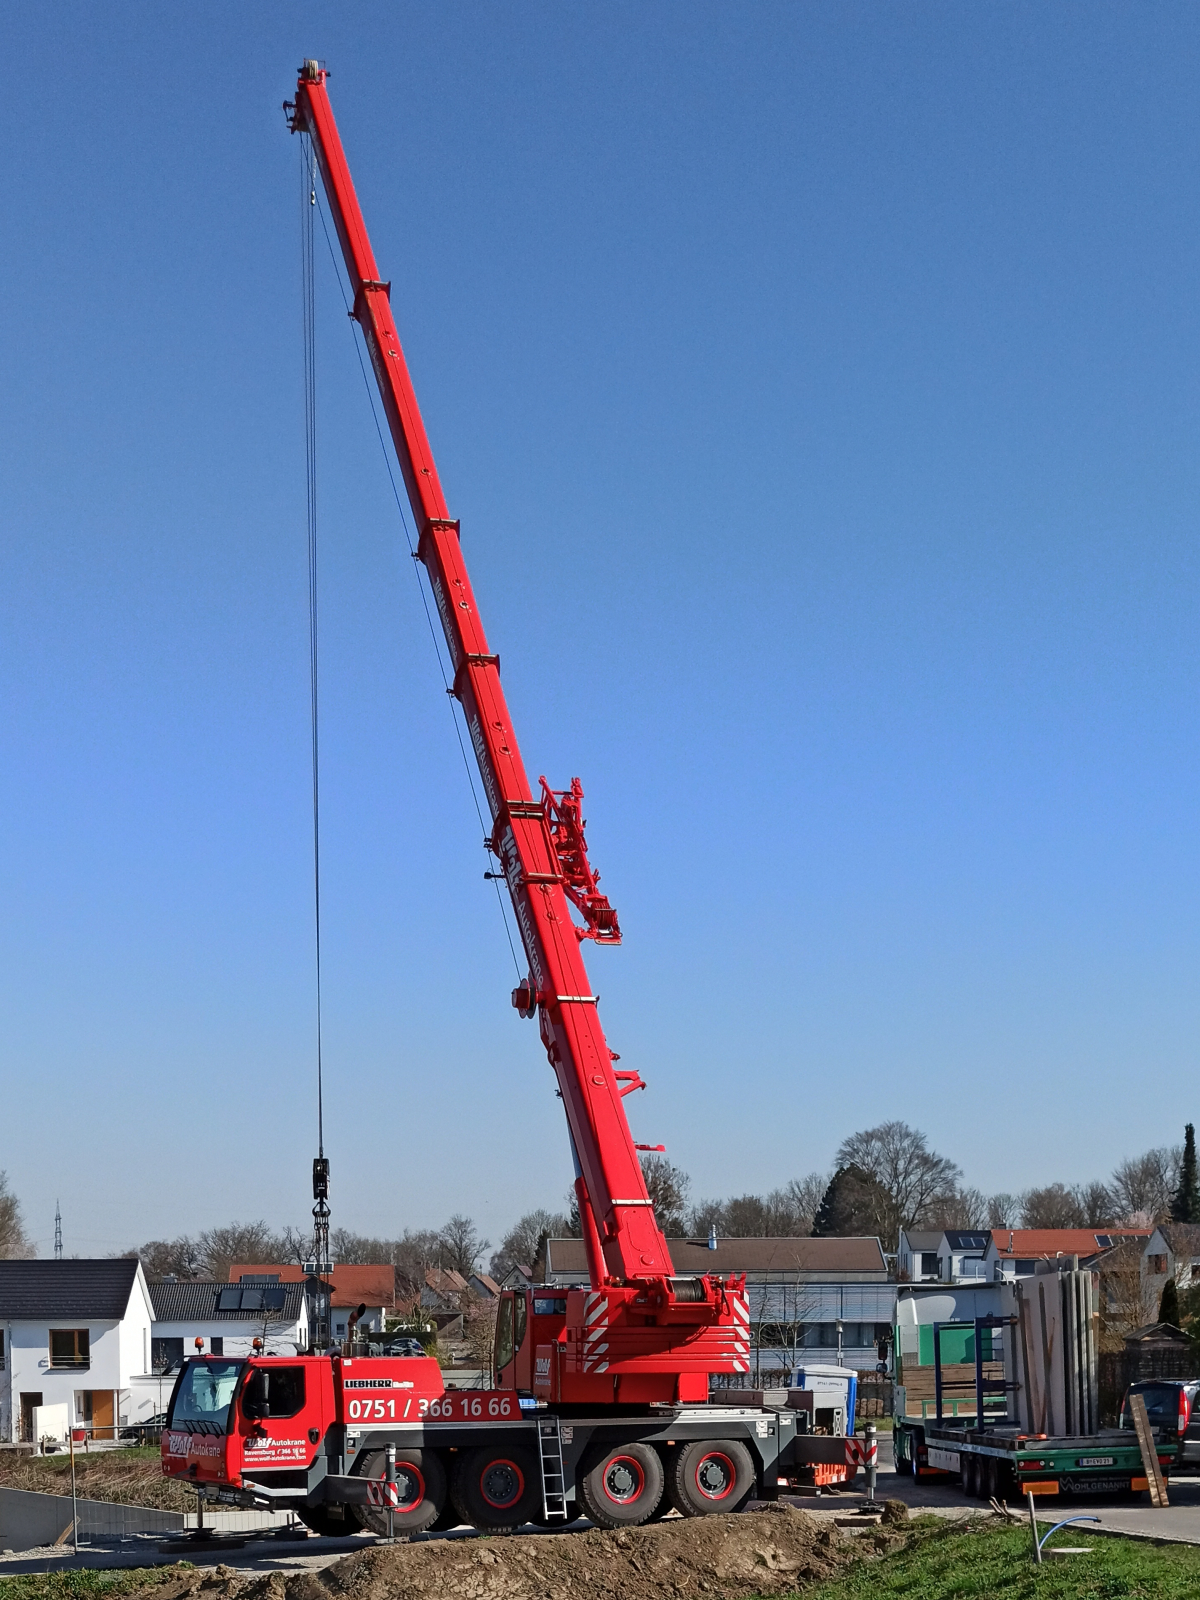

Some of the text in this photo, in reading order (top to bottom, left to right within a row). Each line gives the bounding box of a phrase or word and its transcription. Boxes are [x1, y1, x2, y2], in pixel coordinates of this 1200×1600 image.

[516, 900, 544, 989] Autokrane
[344, 1380, 392, 1388] LIEBHERR
[349, 1398, 511, 1418] 0751 / 366 16 66
[166, 1434, 221, 1458] Wolf Autokrane
[244, 1437, 273, 1449] Wolf
